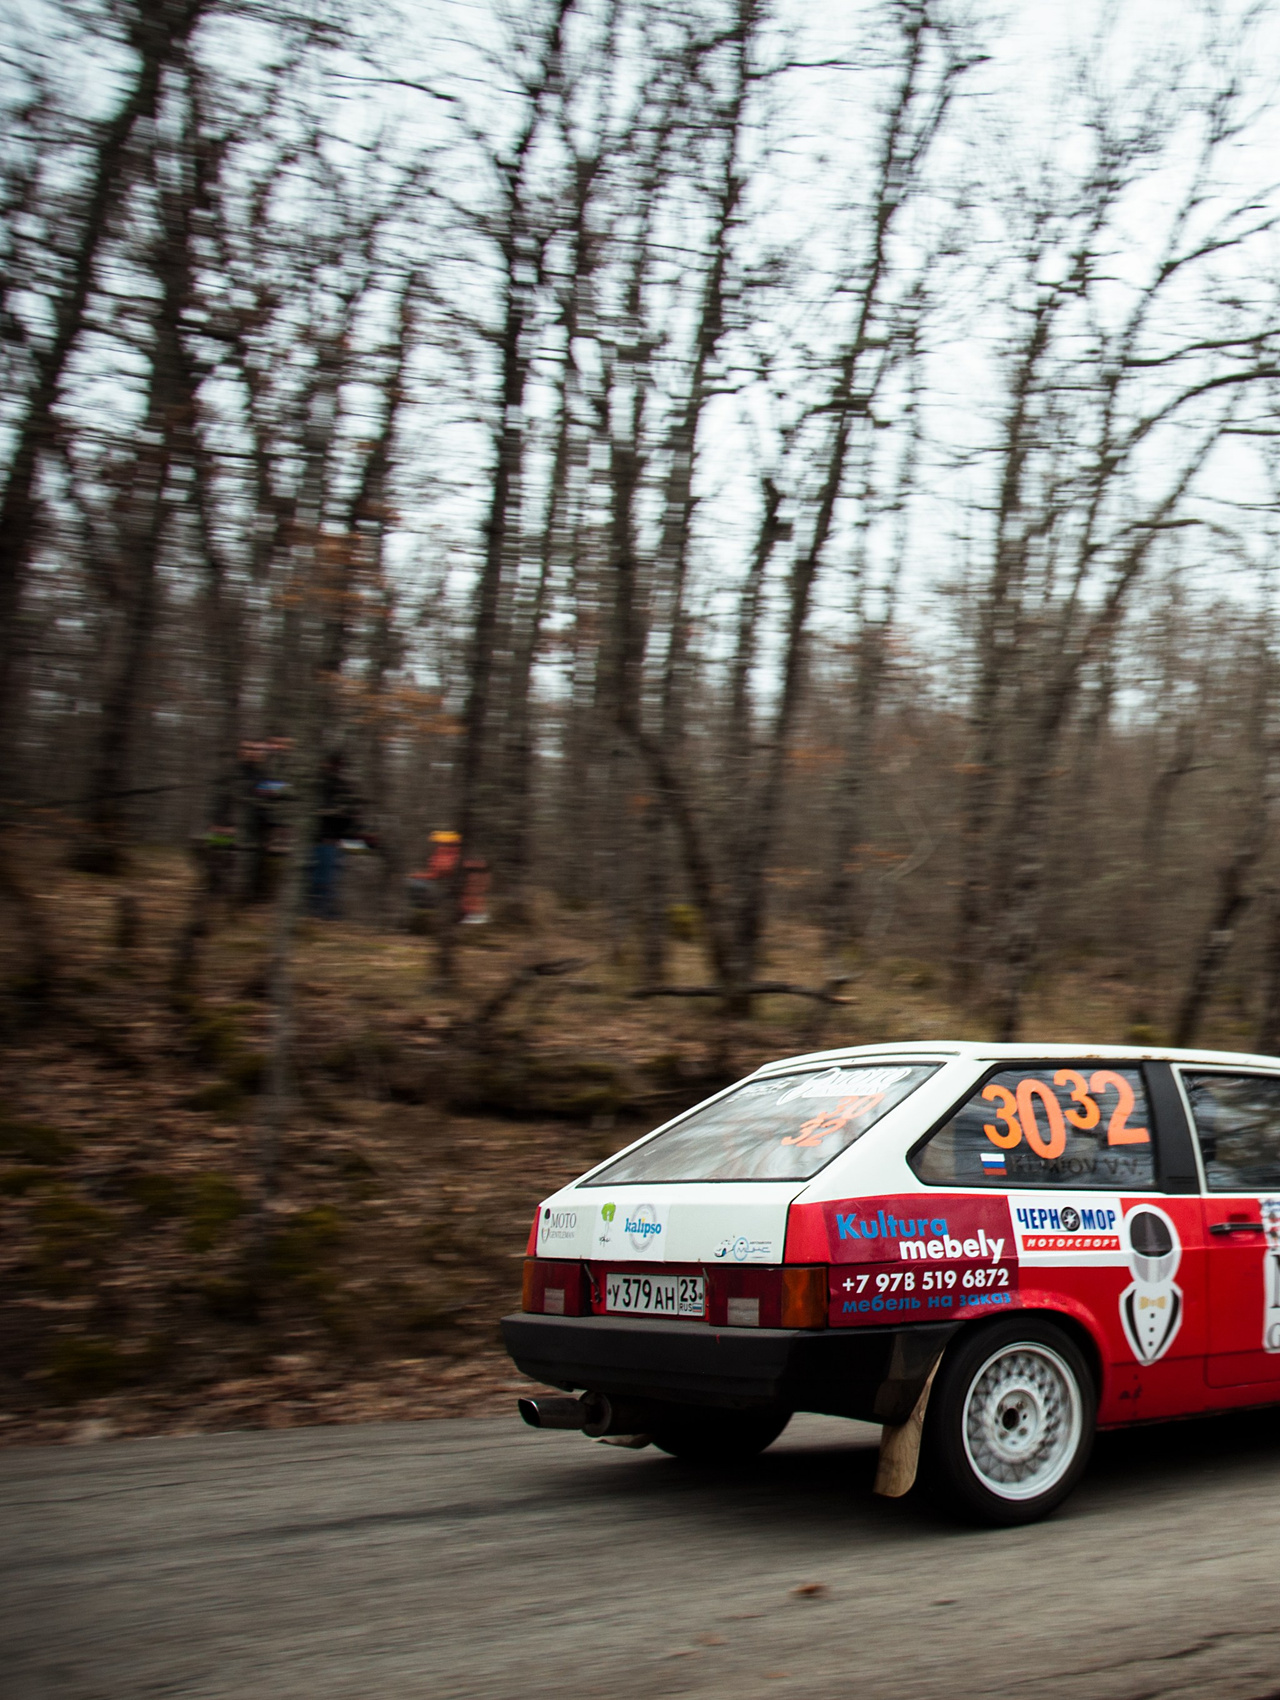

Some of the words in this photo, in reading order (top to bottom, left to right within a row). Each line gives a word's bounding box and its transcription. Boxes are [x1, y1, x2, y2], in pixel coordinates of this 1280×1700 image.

[551, 1213, 577, 1229] MOTO
[624, 1217, 662, 1238] kalipso
[836, 1210, 948, 1240] Kultura
[899, 1229, 1005, 1264] mebely
[680, 1279, 698, 1302] 23
[842, 1274, 870, 1293] +7
[876, 1272, 915, 1292] 978
[922, 1270, 957, 1291] 519
[962, 1268, 1009, 1288] 6872
[679, 1302, 693, 1312] RUS
[842, 1294, 920, 1313] мебель
[928, 1294, 952, 1308] на
[960, 1292, 1011, 1307] заказ
